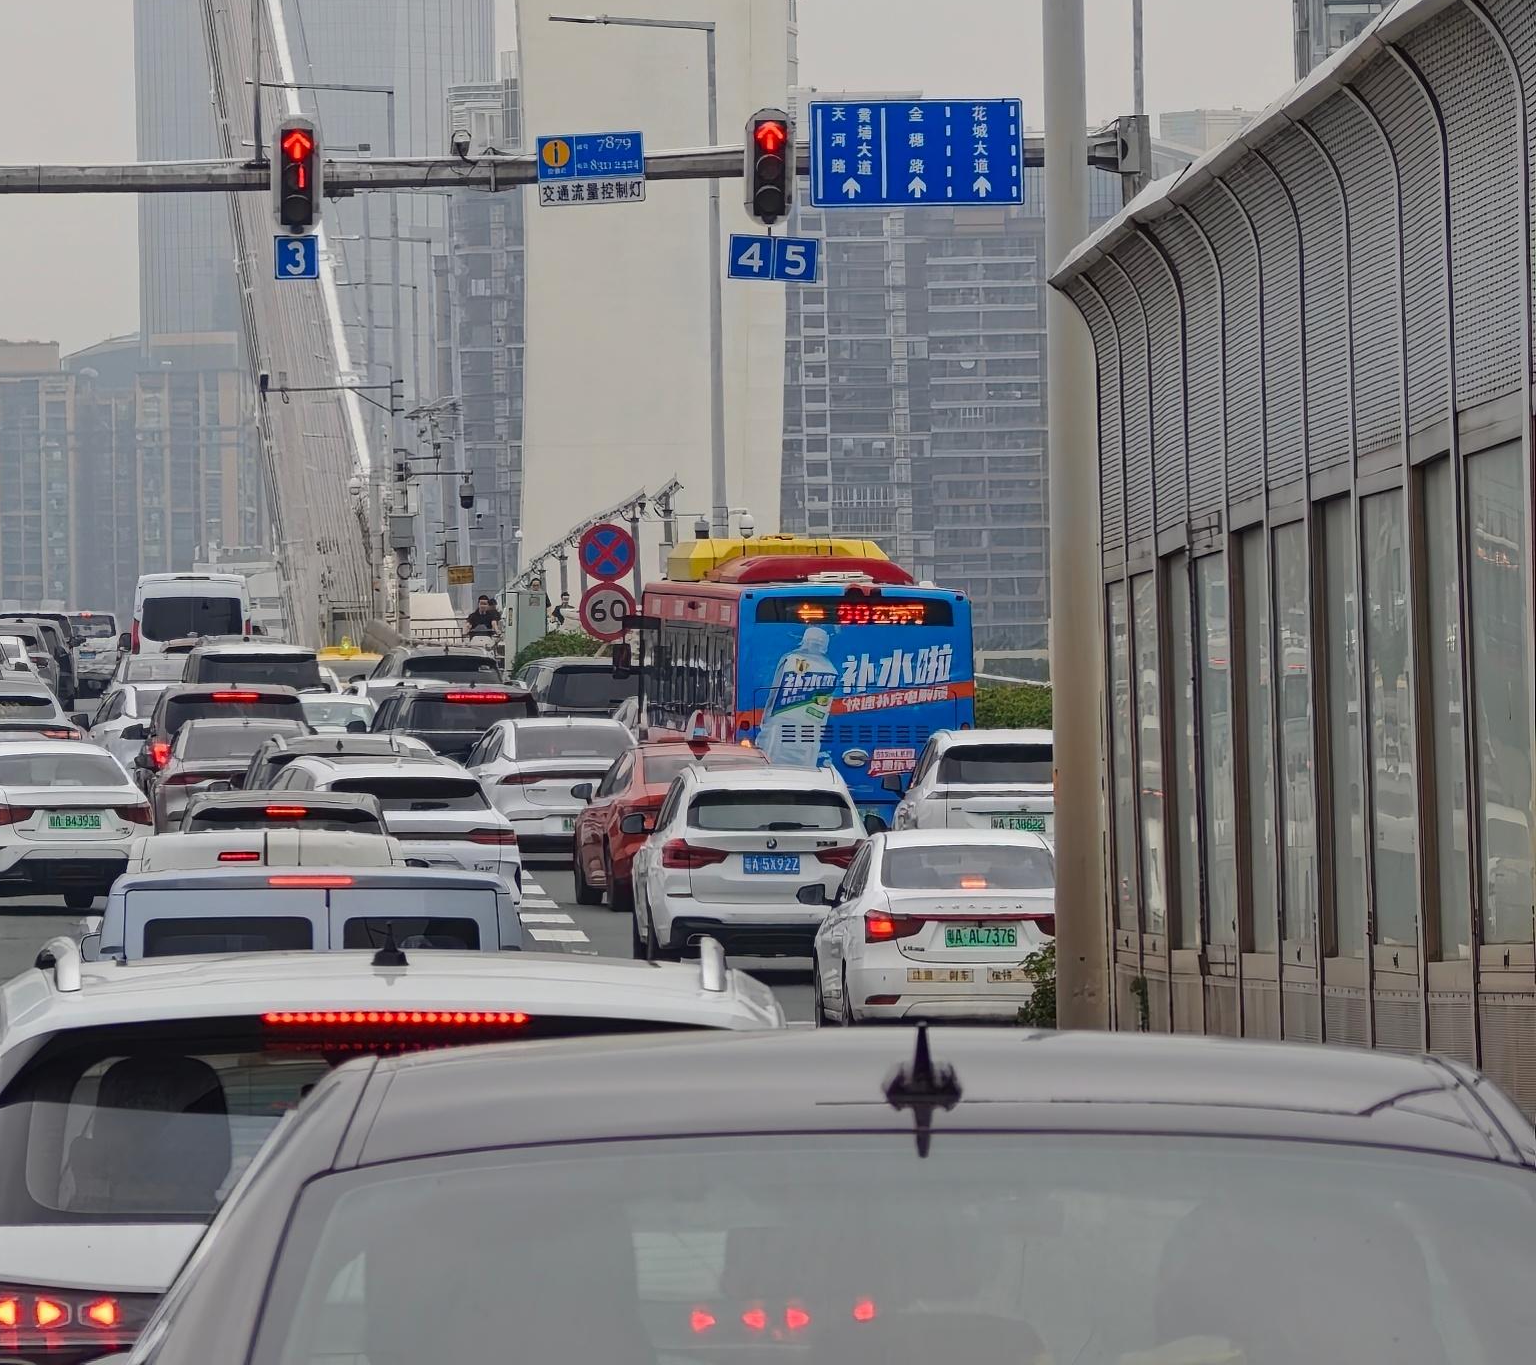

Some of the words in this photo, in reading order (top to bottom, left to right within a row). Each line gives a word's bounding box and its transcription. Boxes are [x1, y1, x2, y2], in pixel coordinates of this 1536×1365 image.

[596, 135, 632, 152] 7879
[831, 107, 846, 173] 天河路
[857, 108, 872, 175] 黄埔大道
[908, 107, 924, 174] 金穗路
[972, 106, 989, 174] 花城大道
[542, 181, 642, 203] 交通流量控制灯
[286, 241, 306, 275] 3
[737, 242, 764, 274] 4
[784, 245, 806, 276] 5
[590, 599, 627, 622] 60
[841, 644, 953, 694] 补水啦
